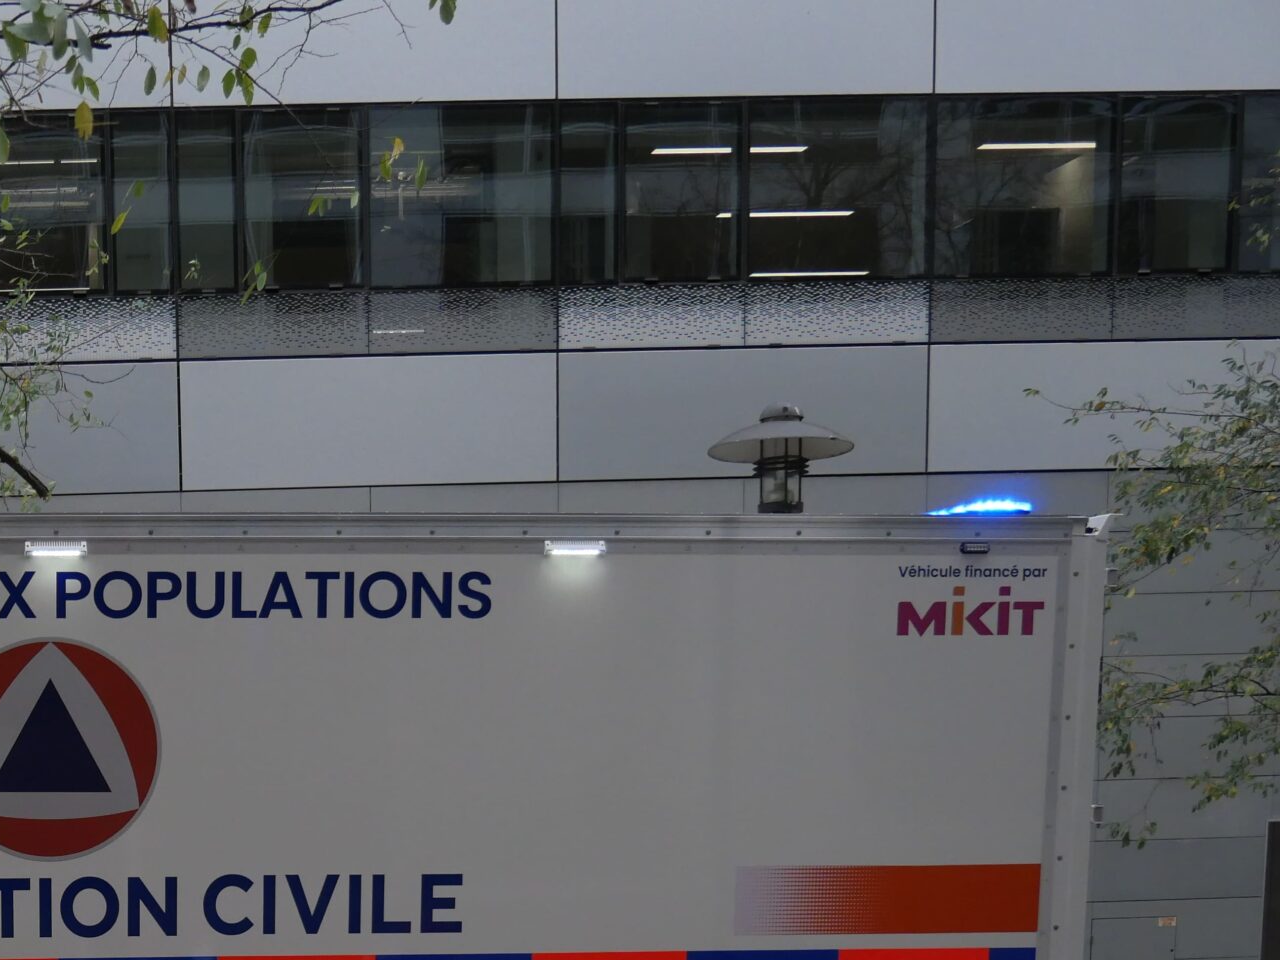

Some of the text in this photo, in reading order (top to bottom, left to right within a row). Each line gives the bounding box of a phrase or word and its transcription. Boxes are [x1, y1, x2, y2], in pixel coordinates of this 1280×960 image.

[55, 570, 493, 619] POPULATIONS
[897, 565, 1048, 581] Véhicule financé par
[202, 873, 463, 936] CIVILE
